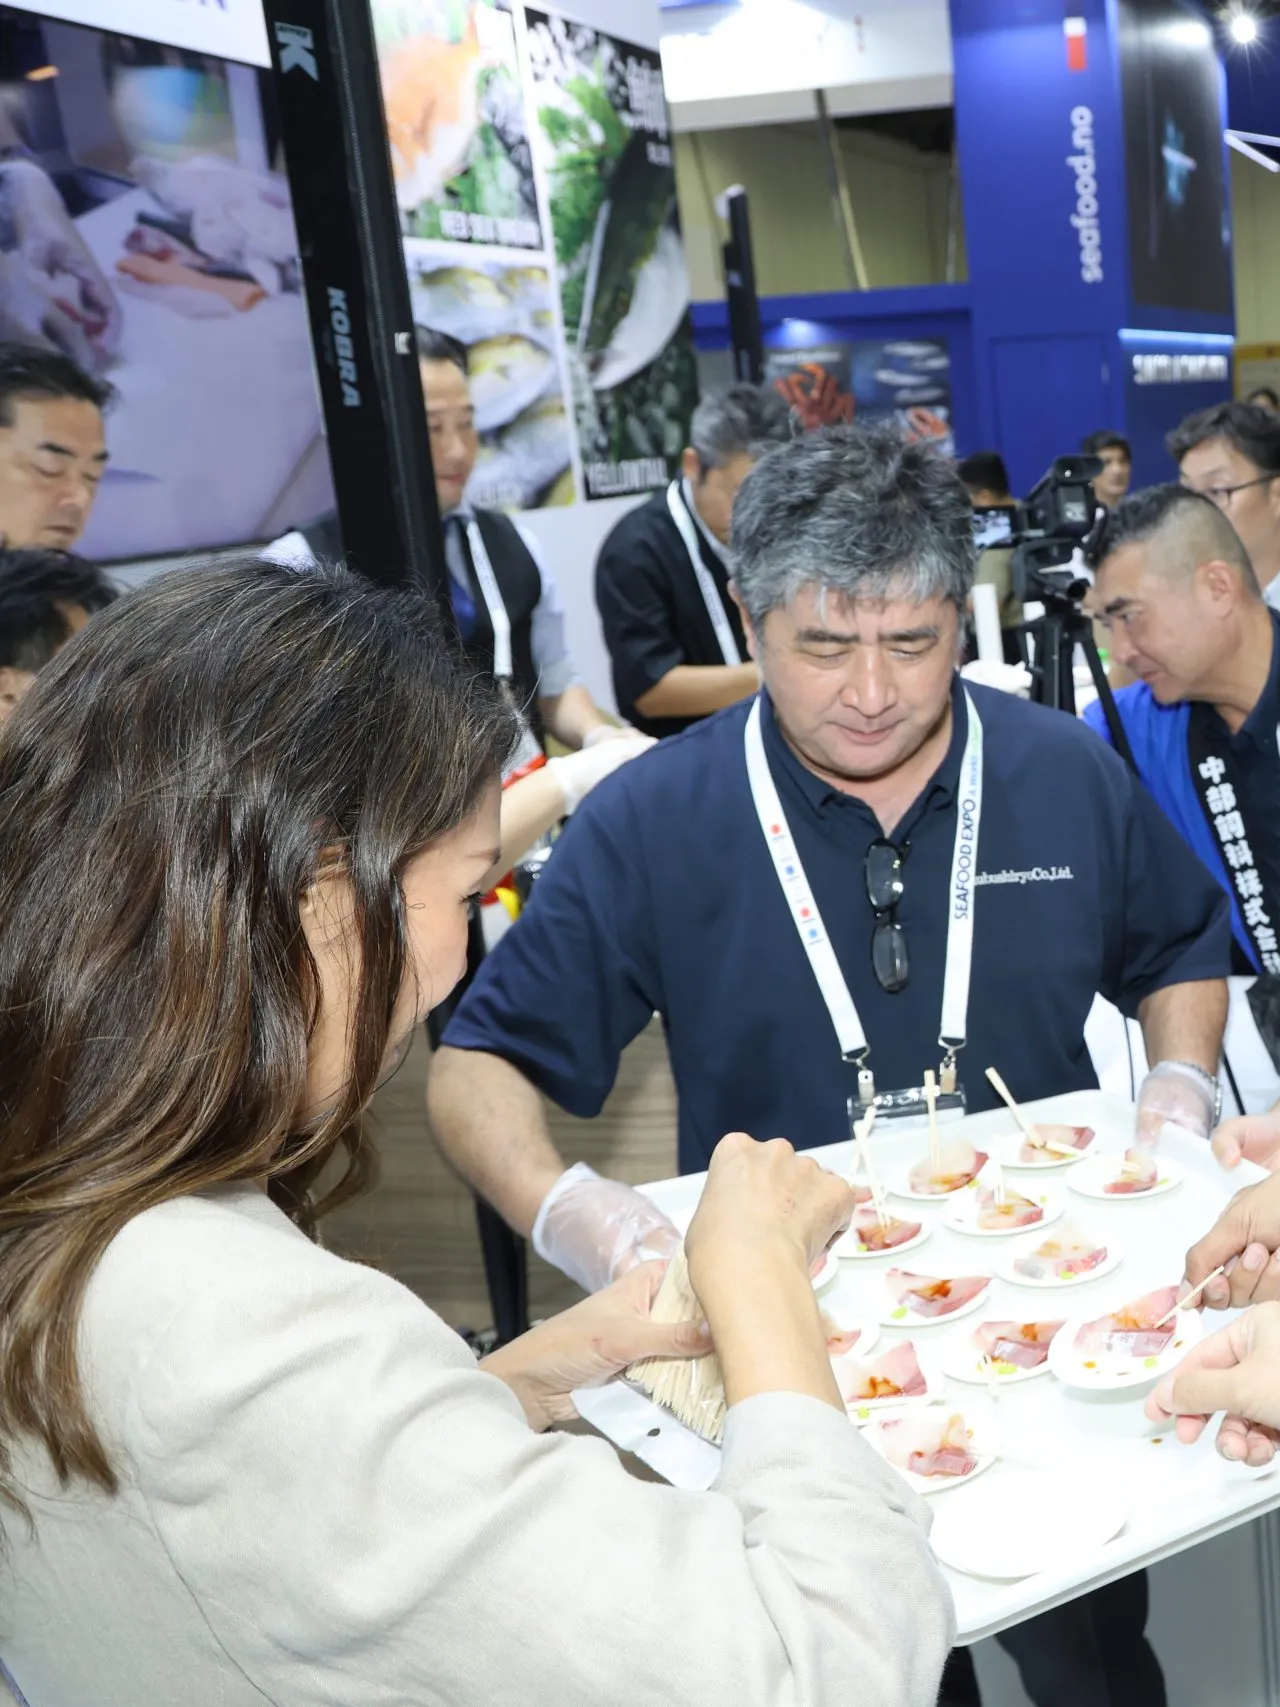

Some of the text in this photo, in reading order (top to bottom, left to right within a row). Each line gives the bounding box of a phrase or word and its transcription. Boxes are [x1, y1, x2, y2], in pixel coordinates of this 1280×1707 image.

[1066, 105, 1104, 283] seafood.no
[327, 286, 361, 406] KOBRA
[960, 799, 977, 841] EXPO
[954, 844, 973, 920] SEAFOOD
